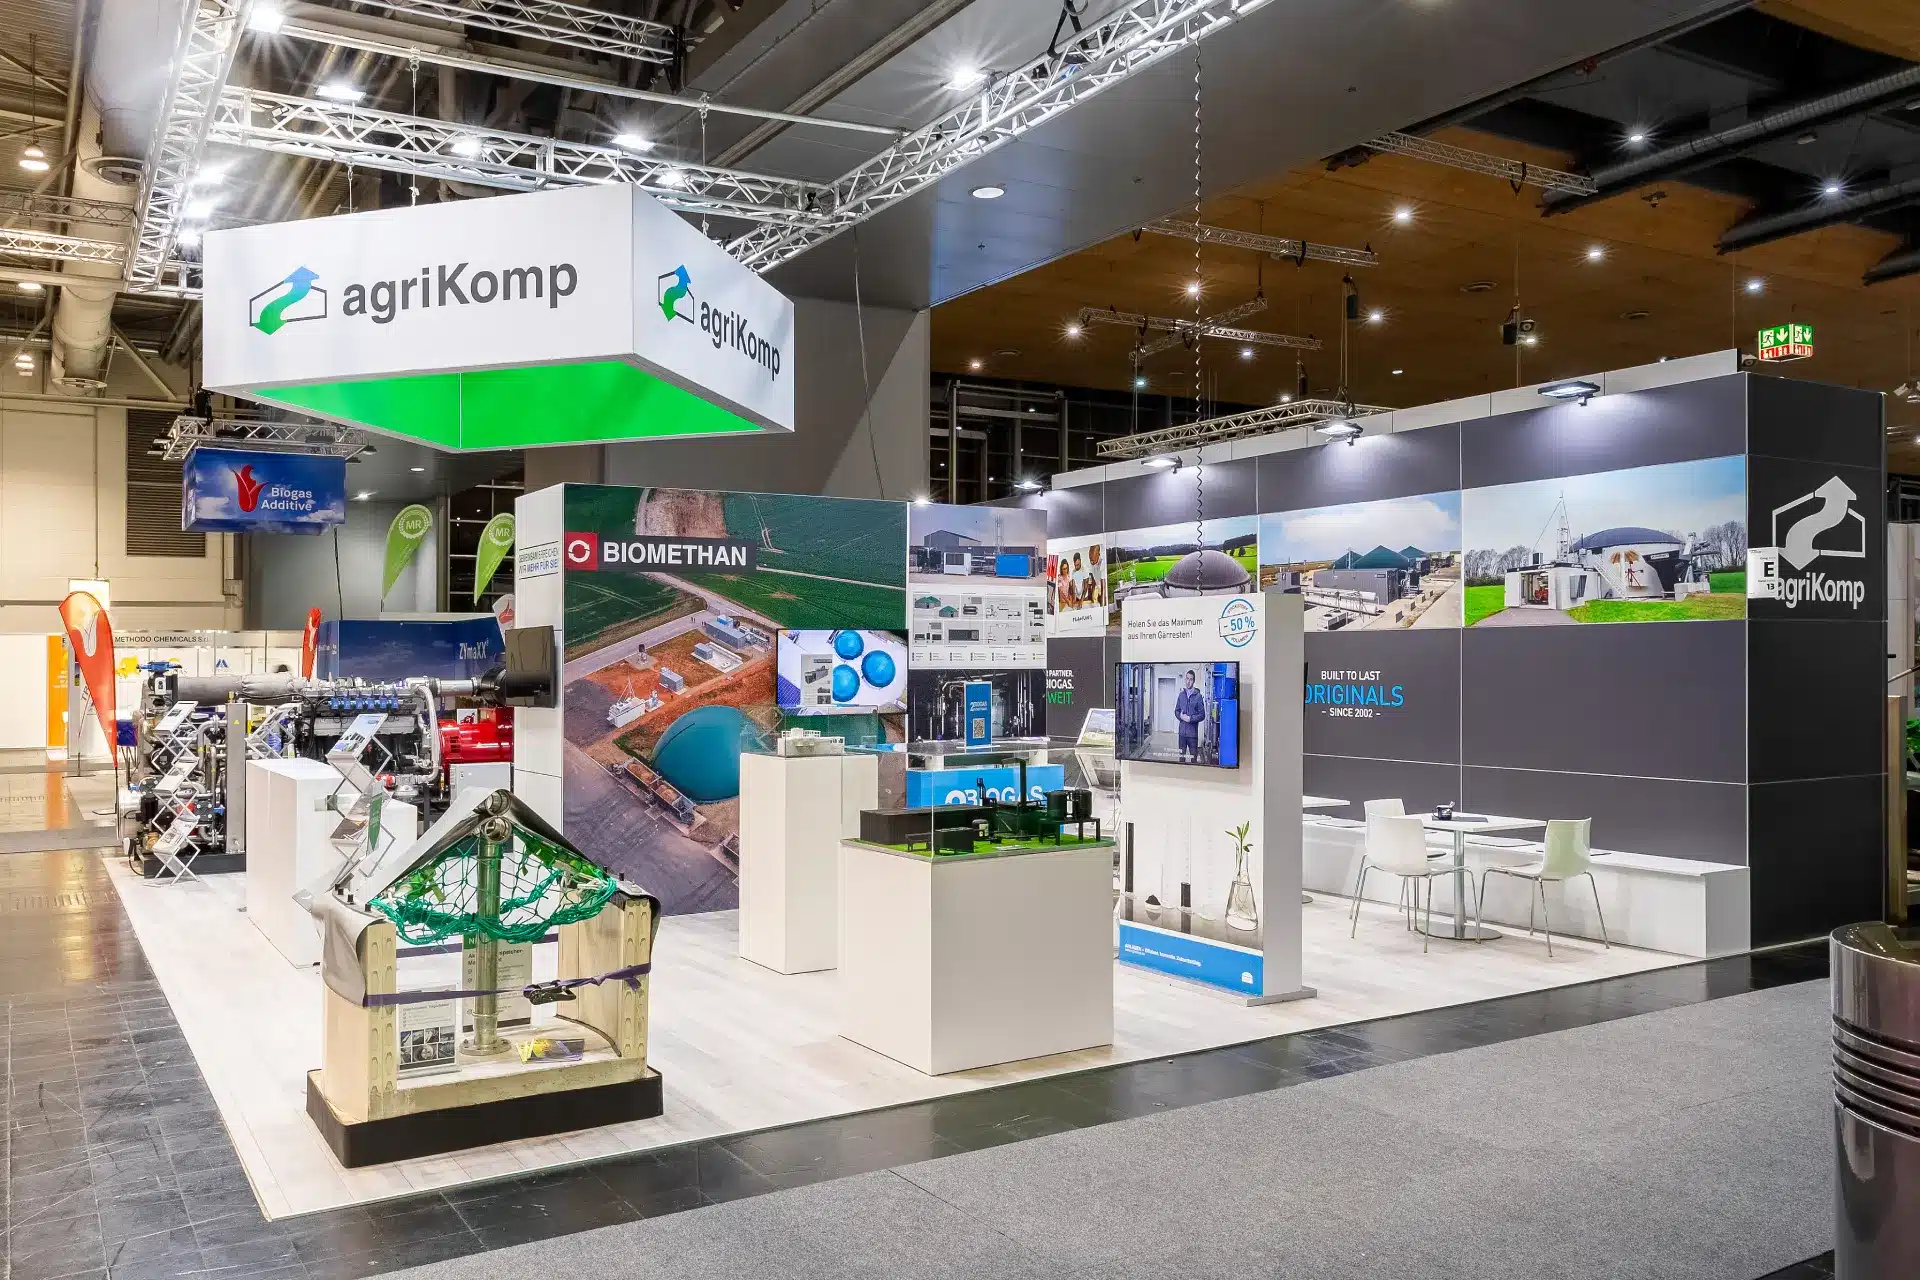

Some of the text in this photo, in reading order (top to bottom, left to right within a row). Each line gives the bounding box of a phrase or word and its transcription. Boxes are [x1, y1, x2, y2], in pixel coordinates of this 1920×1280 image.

[342, 262, 578, 324] agriKomp
[700, 300, 780, 382] agriKomp
[271, 487, 313, 500] Biogas
[261, 499, 313, 511] Additive
[405, 520, 422, 530] MR
[494, 527, 510, 537] MR
[603, 541, 747, 567] BIOMETHAN
[1763, 561, 1775, 578] E
[1775, 571, 1865, 610] agriKomp
[1127, 617, 1203, 629] Holen Sie das Maximum
[1230, 617, 1243, 632] 50
[1127, 632, 1139, 640] aus
[1140, 631, 1157, 640] Ihren
[1048, 669, 1074, 678] PARTNER.
[1321, 670, 1381, 681] BUILT TO LAST
[1305, 684, 1405, 707] ORIGINALS
[1329, 707, 1354, 717] SINCE
[1354, 708, 1373, 718] 2002
